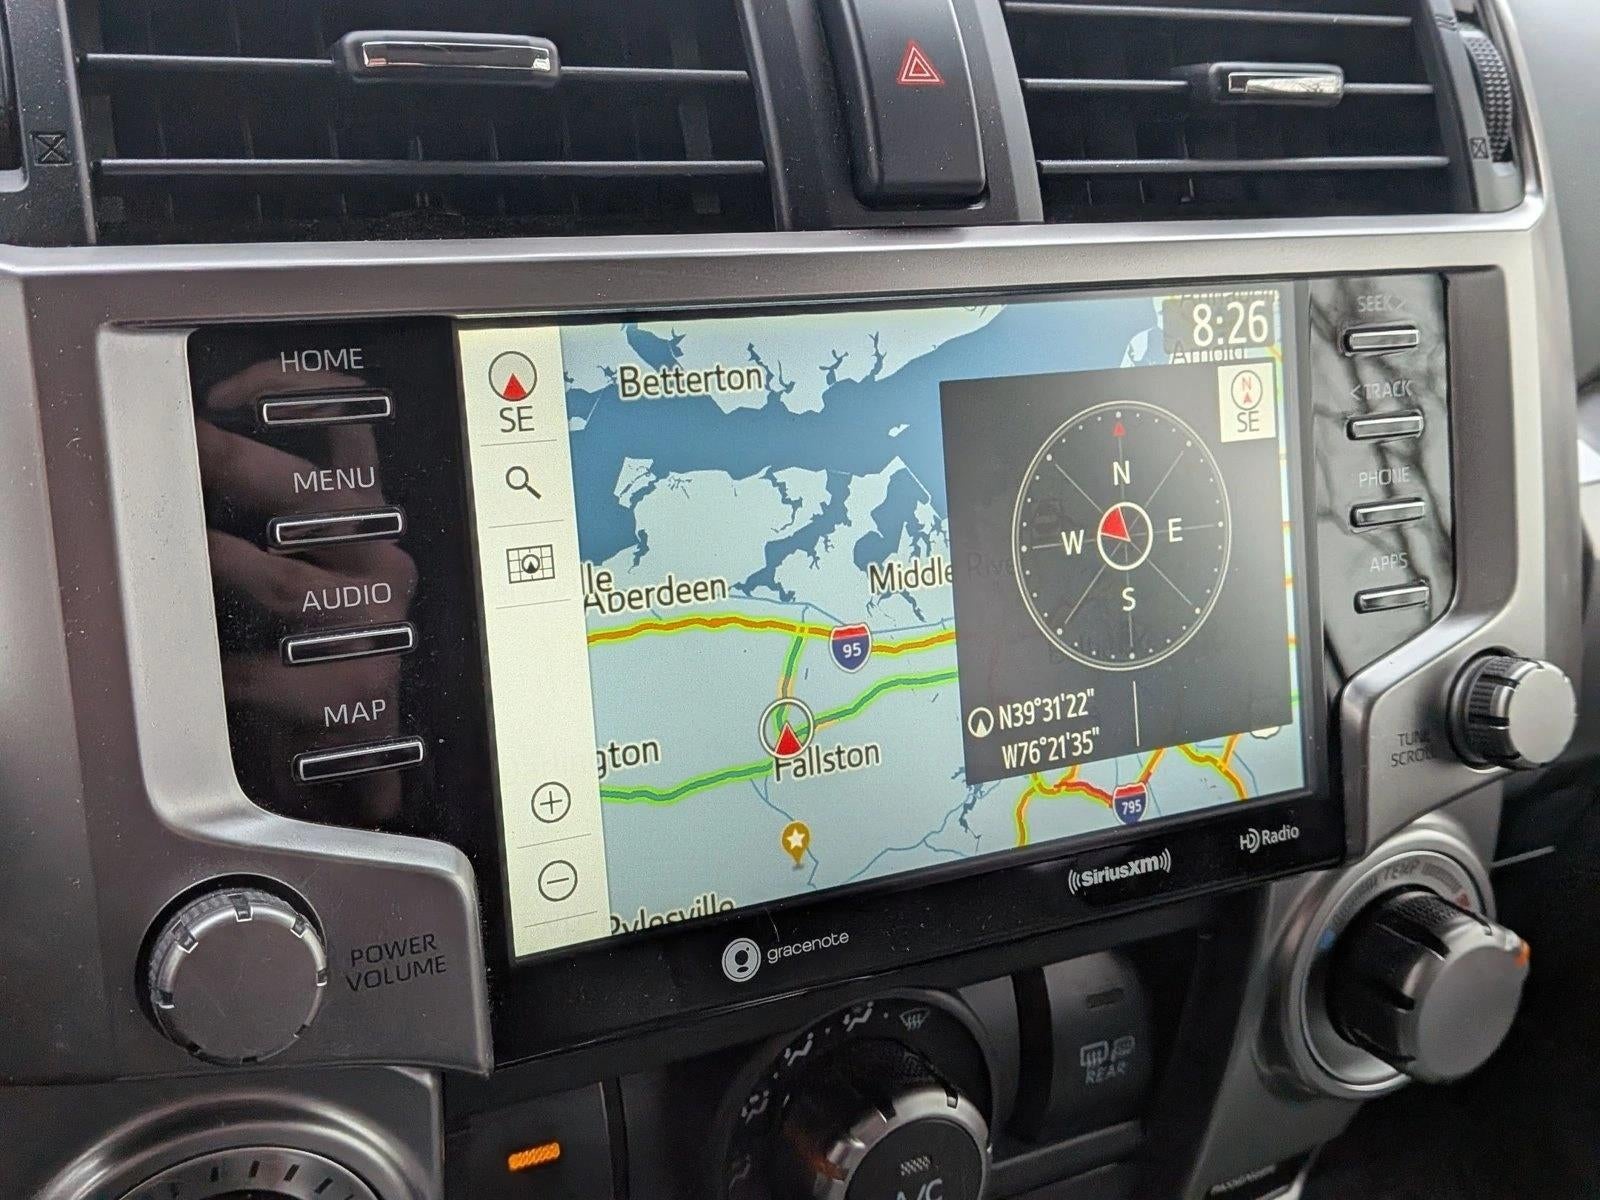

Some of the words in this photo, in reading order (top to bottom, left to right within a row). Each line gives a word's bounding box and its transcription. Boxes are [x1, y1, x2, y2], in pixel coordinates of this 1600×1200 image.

[1357, 295, 1393, 313] SEEK
[1192, 300, 1269, 347] 8:26
[280, 347, 364, 373] HOME
[618, 364, 764, 397] Betterton
[1364, 379, 1413, 399] TRACK
[499, 405, 535, 433] SE
[1236, 410, 1260, 433] SE
[293, 466, 376, 494] MENU
[1112, 460, 1132, 486] N
[1359, 465, 1410, 488] PHONE
[1061, 529, 1085, 556] W
[1168, 517, 1184, 543] E
[1369, 552, 1408, 573] APPS
[302, 582, 392, 613] AUDIO
[584, 574, 727, 615] Aberdeen
[1122, 586, 1137, 612] S
[842, 642, 863, 658] 95
[324, 698, 387, 728] MAP
[774, 744, 880, 782] Fallston
[1121, 799, 1142, 815] 795
[1262, 824, 1300, 846] Radio
[350, 933, 438, 968] POWER
[767, 932, 850, 964] gracenote
[345, 955, 448, 992] VOLUME
